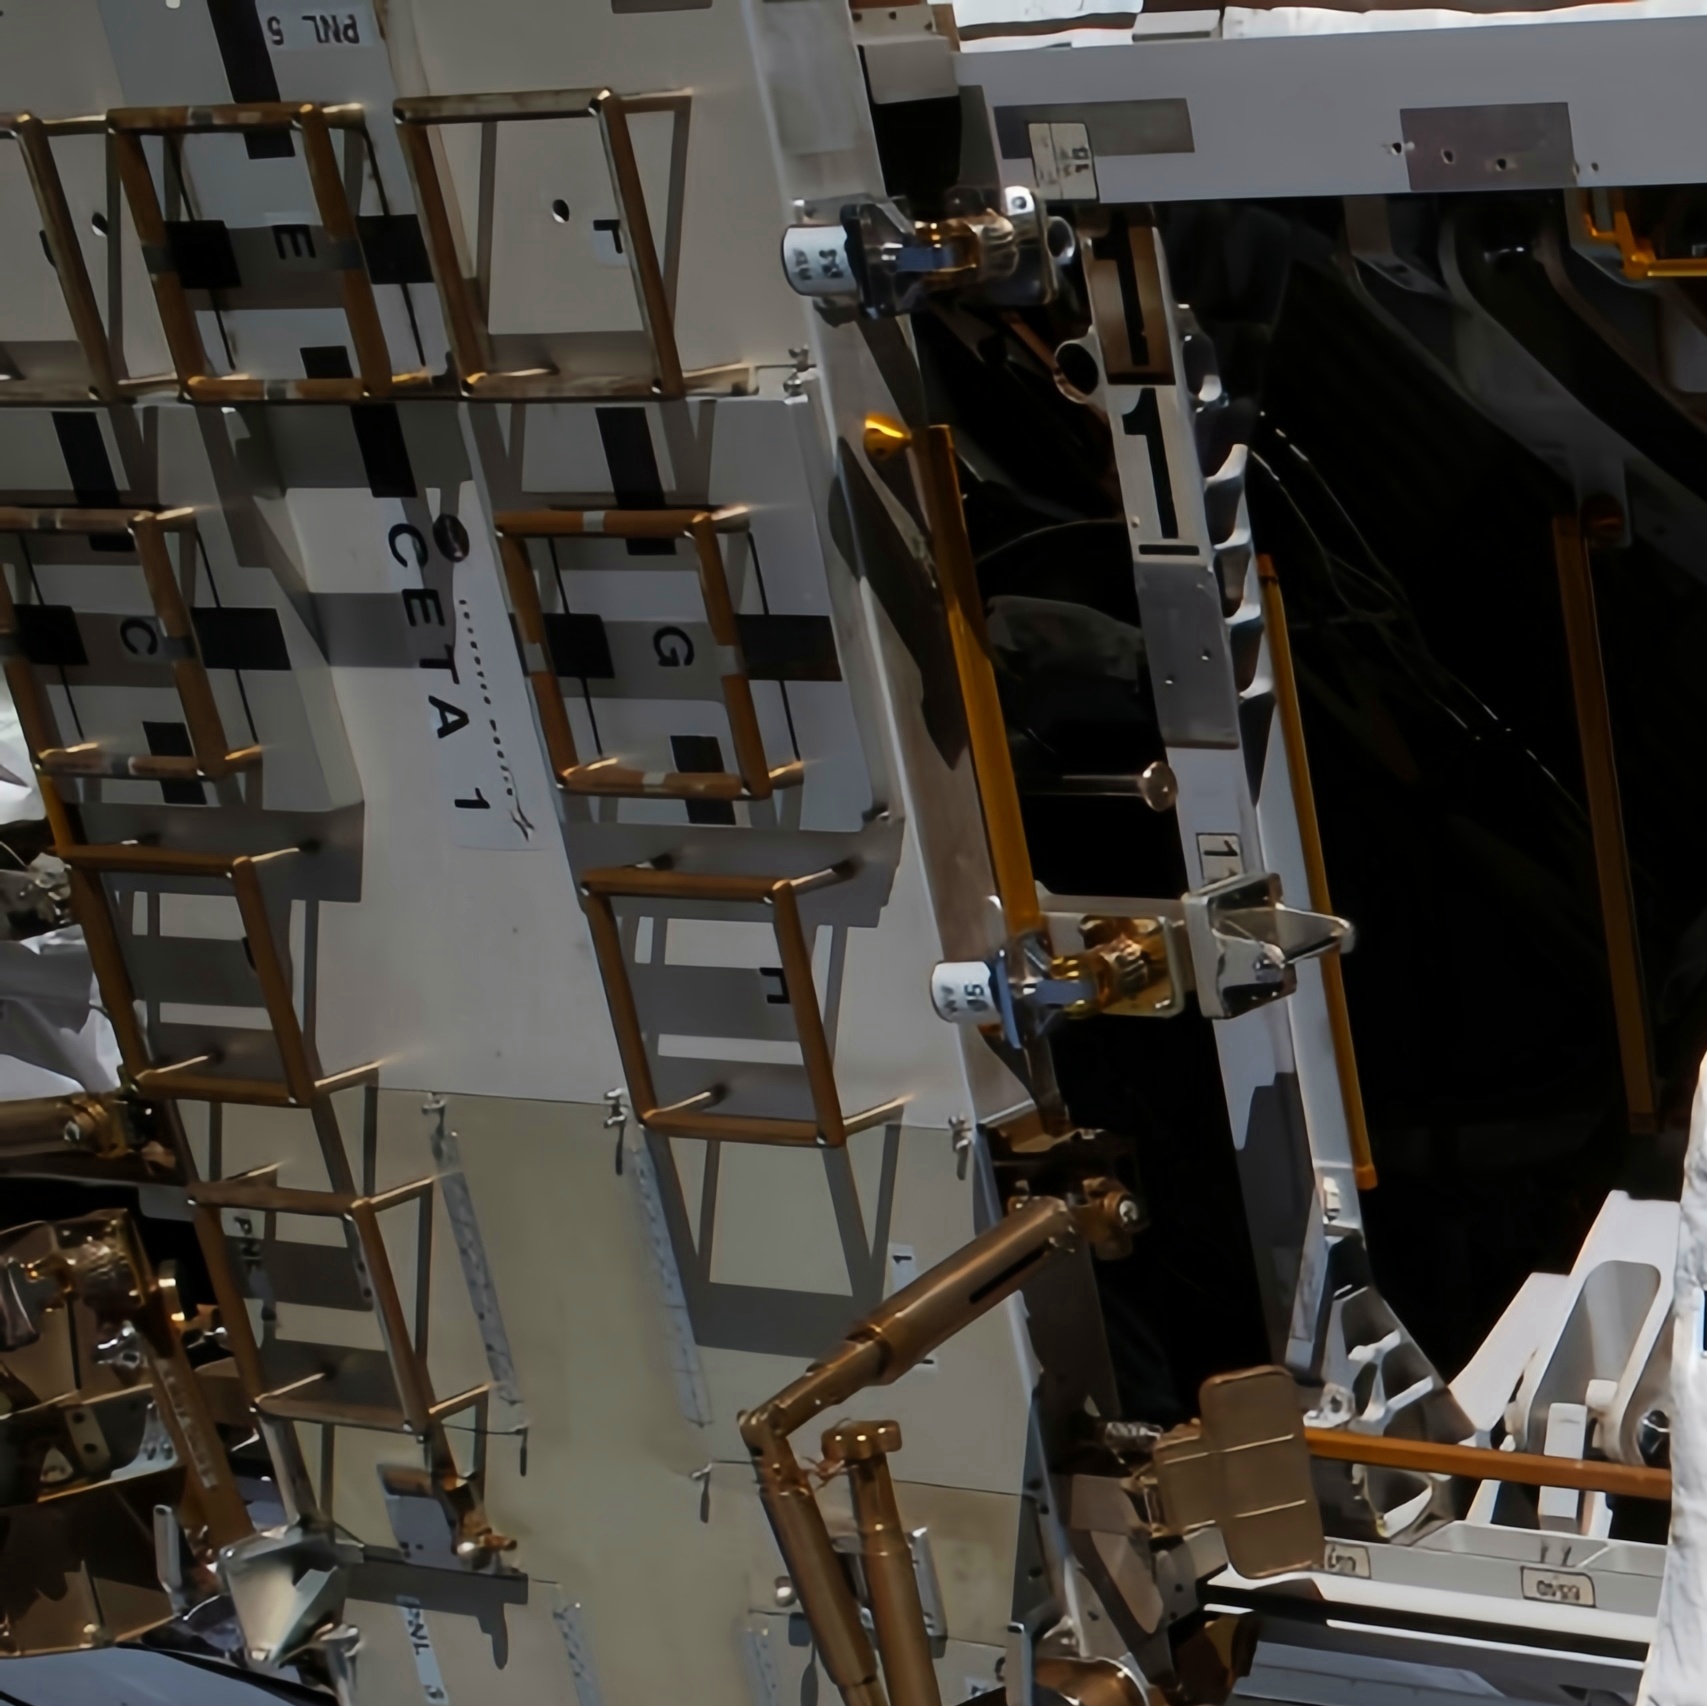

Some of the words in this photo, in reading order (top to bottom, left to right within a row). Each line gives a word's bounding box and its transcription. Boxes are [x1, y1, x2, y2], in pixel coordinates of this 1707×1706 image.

[302, 13, 360, 44] PNL
[271, 223, 317, 261] E
[1121, 387, 1179, 539] 1
[119, 617, 159, 656] C
[388, 523, 470, 739] CETA
[652, 626, 695, 668] G
